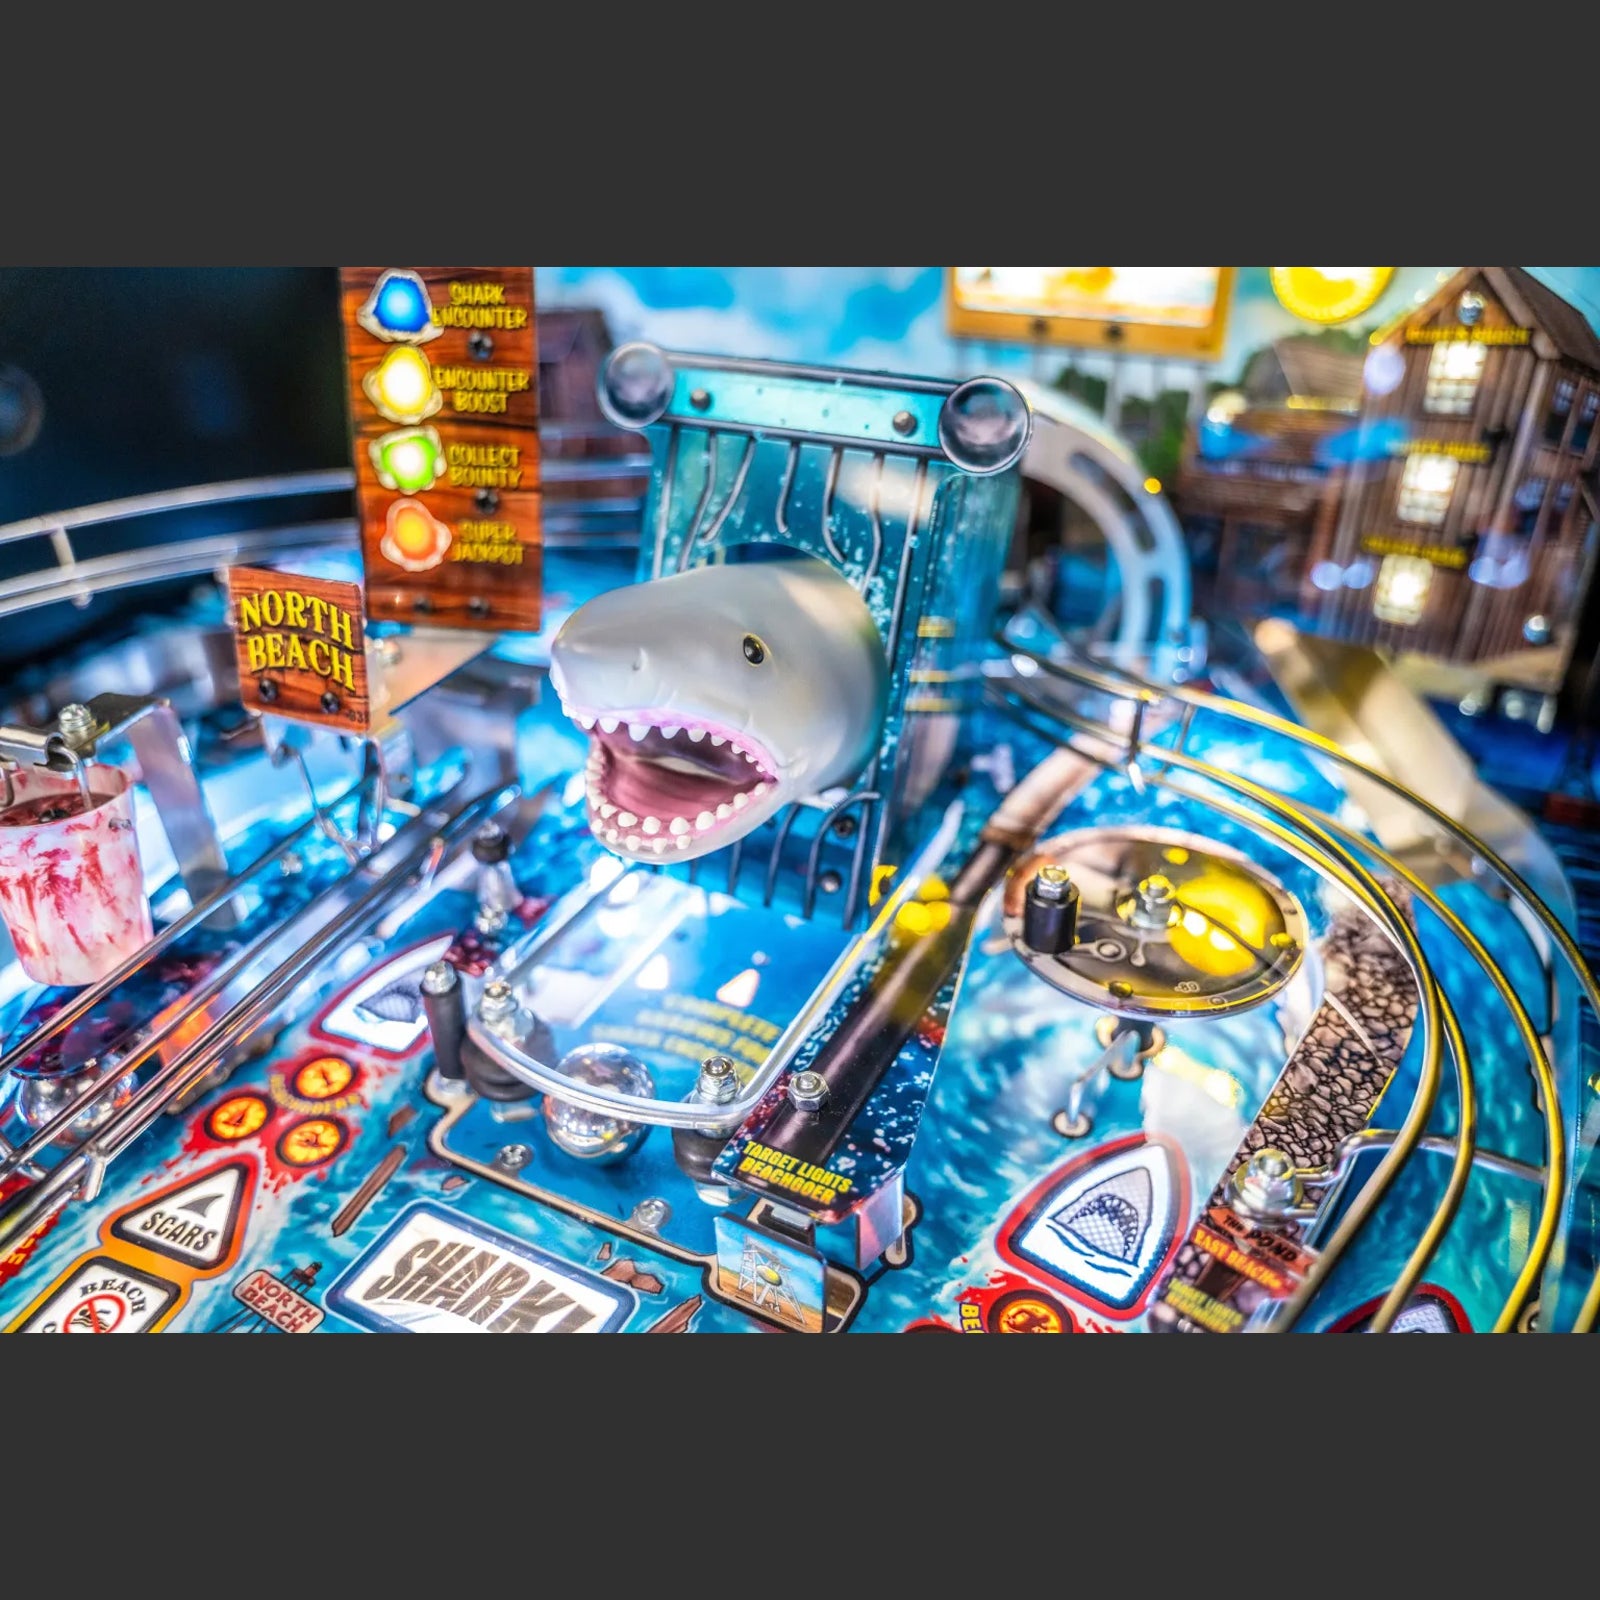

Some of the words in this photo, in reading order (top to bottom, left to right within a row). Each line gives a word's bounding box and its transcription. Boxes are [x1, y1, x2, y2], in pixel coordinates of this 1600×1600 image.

[449, 281, 506, 305] SHARK
[431, 306, 528, 329] ENCOUNTER
[432, 365, 530, 392] ENCOUNTER
[452, 391, 508, 413] BOOST
[449, 443, 520, 467] COLLECT
[449, 466, 522, 488] BOUNTY
[459, 520, 517, 543] SUPER
[451, 543, 524, 565] JACKPOT
[240, 589, 355, 651] NORTH
[246, 632, 356, 693] BEACH
[738, 1156, 836, 1205] BEACHGOER
[742, 1140, 800, 1171] TARGET
[797, 1162, 853, 1193] LIGHTS
[141, 1211, 218, 1251] SCARS
[1193, 1228, 1230, 1260] EAST
[78, 1278, 148, 1316] BEACH
[240, 1286, 304, 1333] BEACH
[251, 1274, 319, 1323] NORTH
